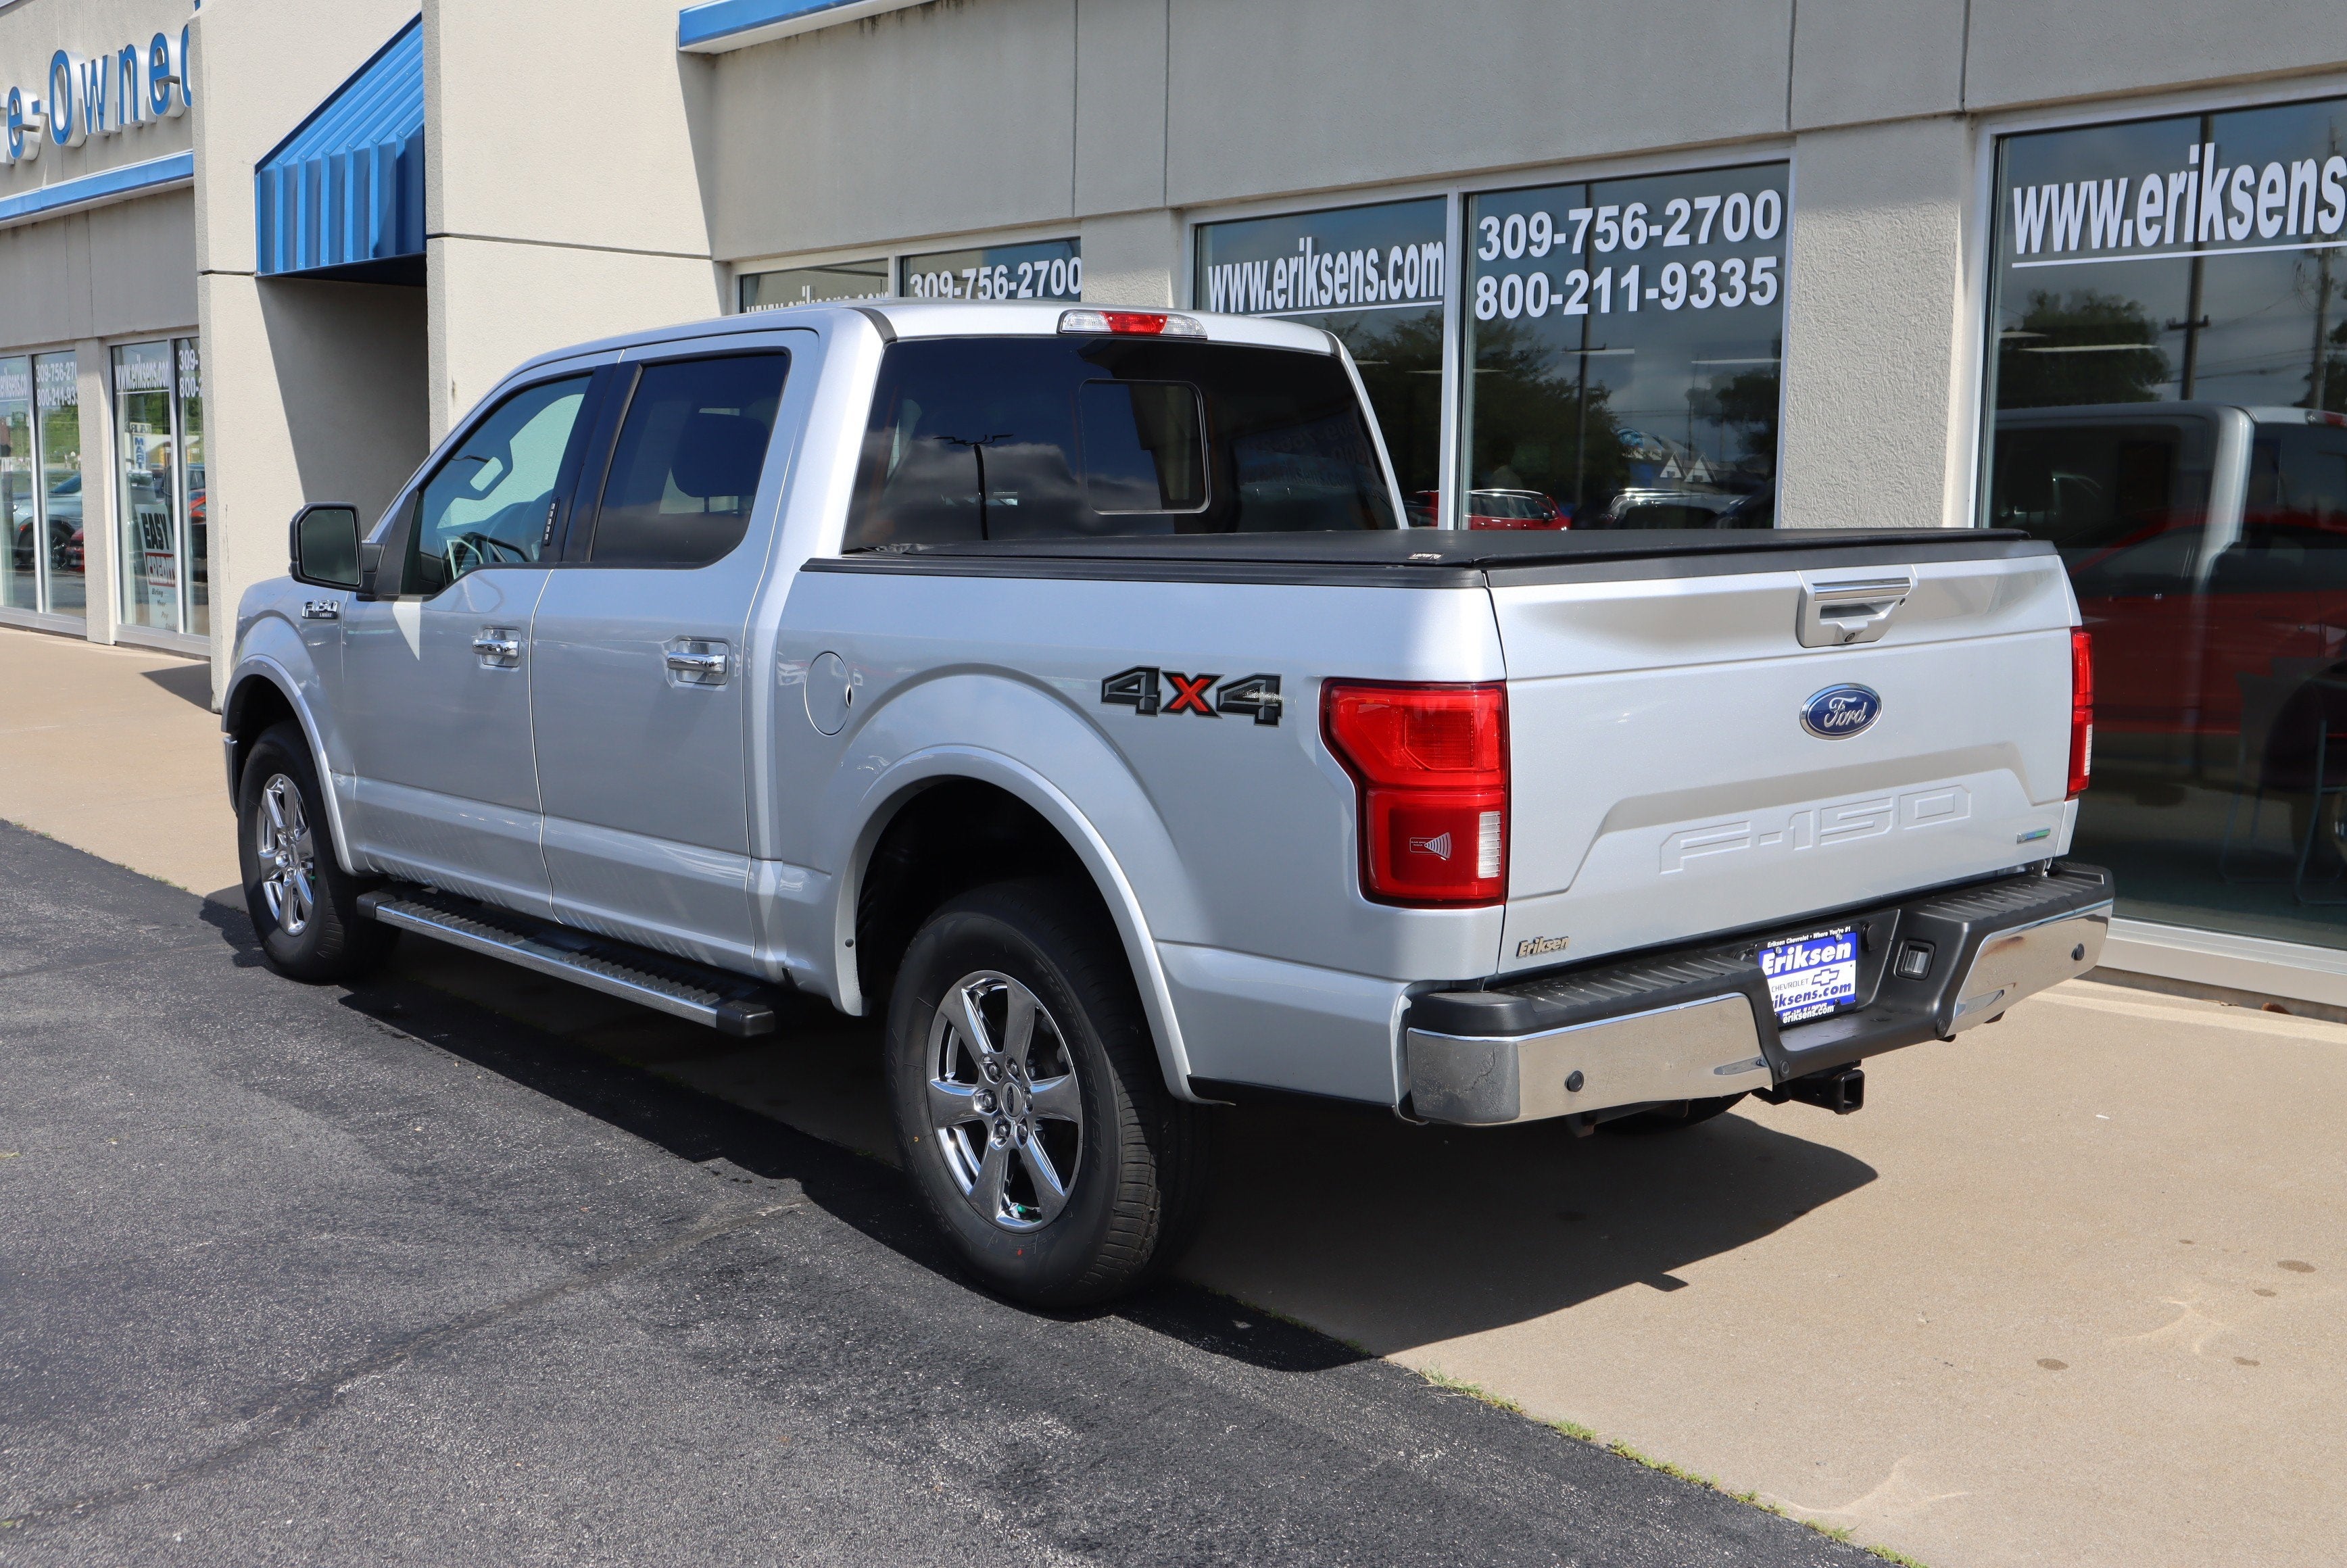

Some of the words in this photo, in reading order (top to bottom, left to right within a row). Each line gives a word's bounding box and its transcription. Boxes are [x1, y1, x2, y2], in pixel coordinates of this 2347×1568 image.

[2013, 142, 2347, 255] www.eriksens
[1478, 189, 1782, 261] 309-756-2700
[909, 256, 1082, 300] 309-756-2700
[1207, 237, 1445, 313] www.eriksens.com
[1475, 255, 1778, 320] 800-211-9335
[141, 512, 170, 551] EASY
[1823, 696, 1868, 728] Ford
[1660, 784, 1972, 875] F-150
[1516, 936, 1570, 958] Eriksen
[1762, 941, 1852, 975] Eriksen
[1767, 939, 1785, 948] Eriksen
[1786, 936, 1809, 944] Chevrolet
[1771, 978, 1810, 993] CHEVROLET
[1772, 983, 1852, 1009] iksens.com
[1783, 1004, 1835, 1024] eriksens.com
